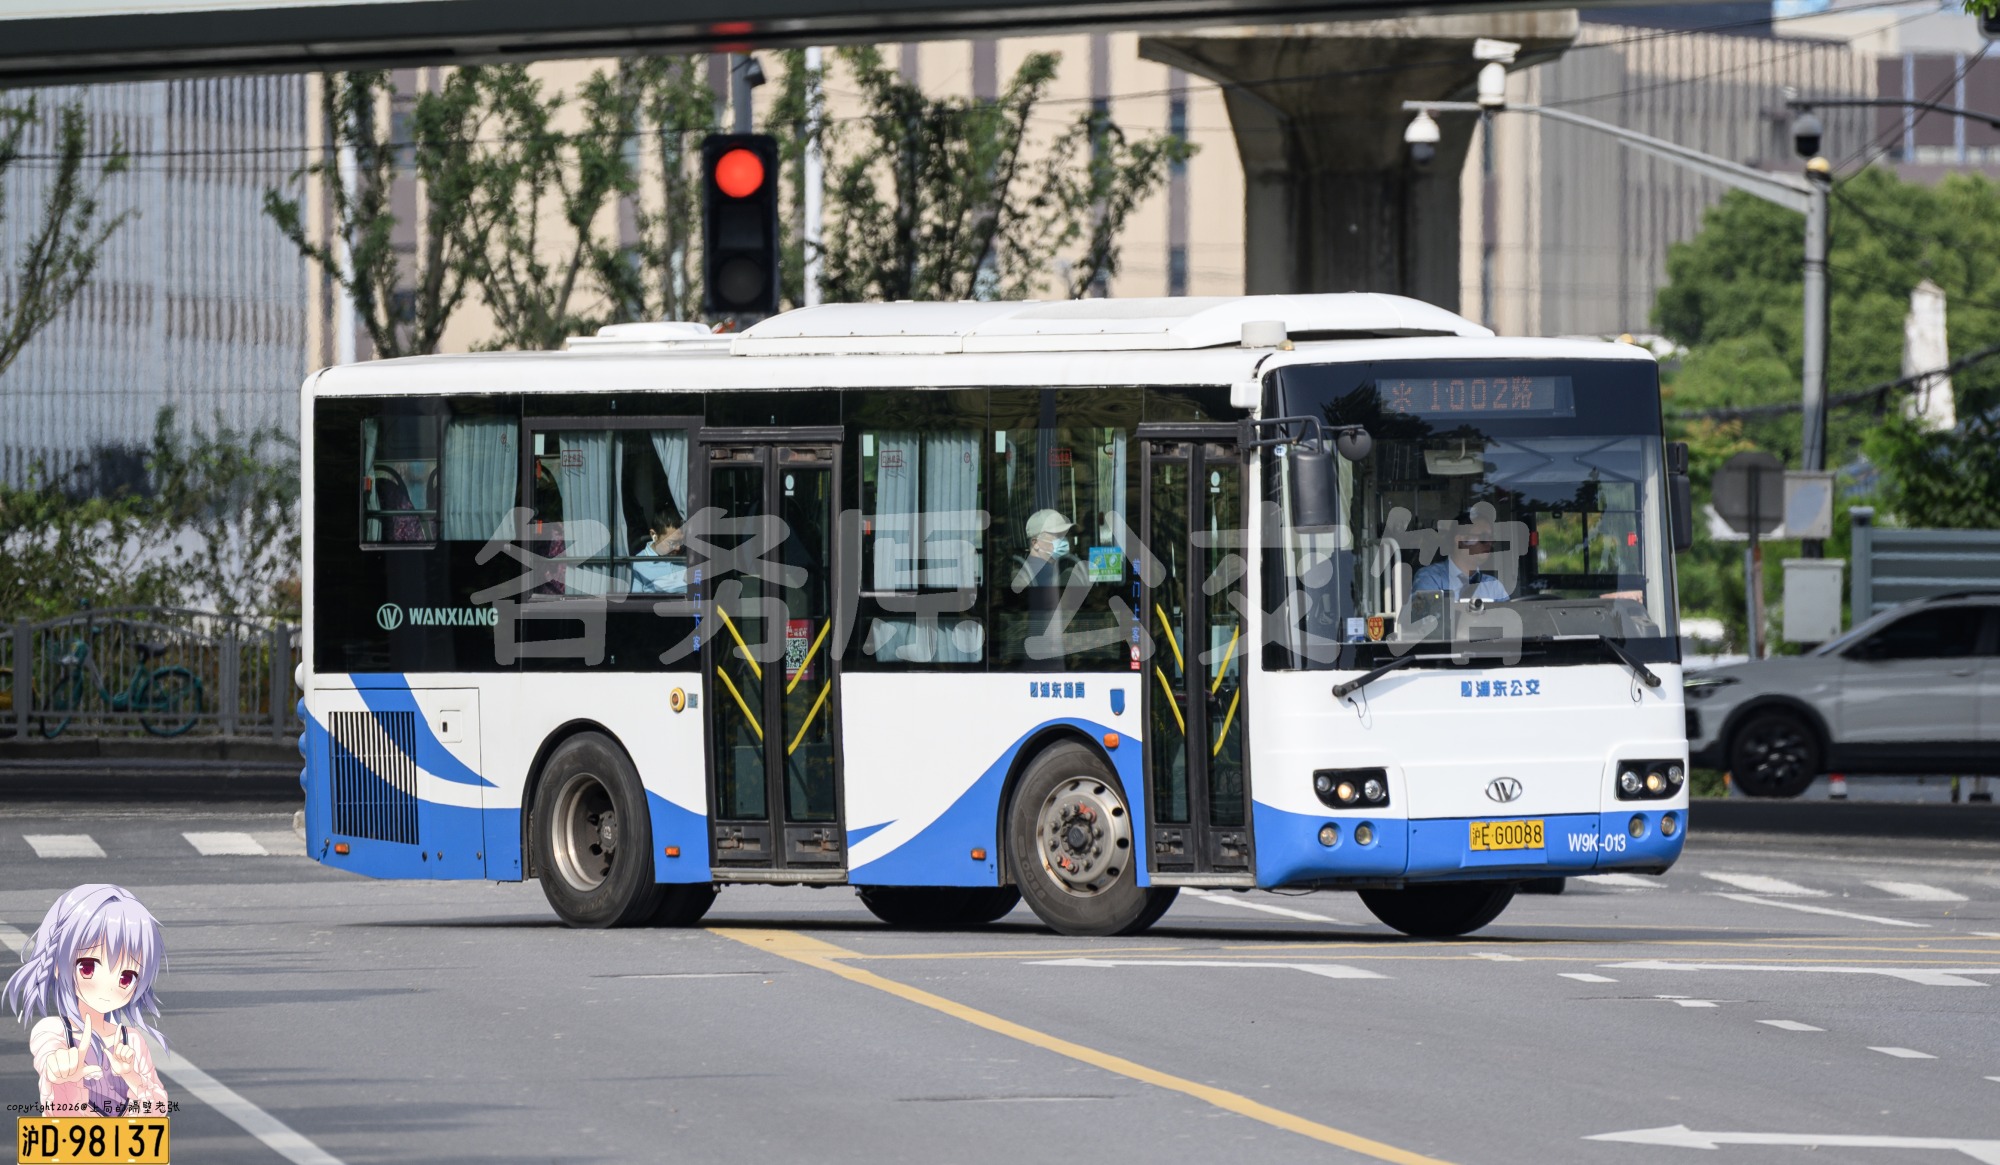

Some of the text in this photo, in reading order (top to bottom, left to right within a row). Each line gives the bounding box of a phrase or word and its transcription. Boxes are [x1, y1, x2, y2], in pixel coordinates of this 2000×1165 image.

[1431, 376, 1533, 411] 1002路
[408, 607, 499, 626] WANXIANG
[1475, 679, 1540, 698] 浦东公交
[1568, 833, 1626, 853] W9K-013
